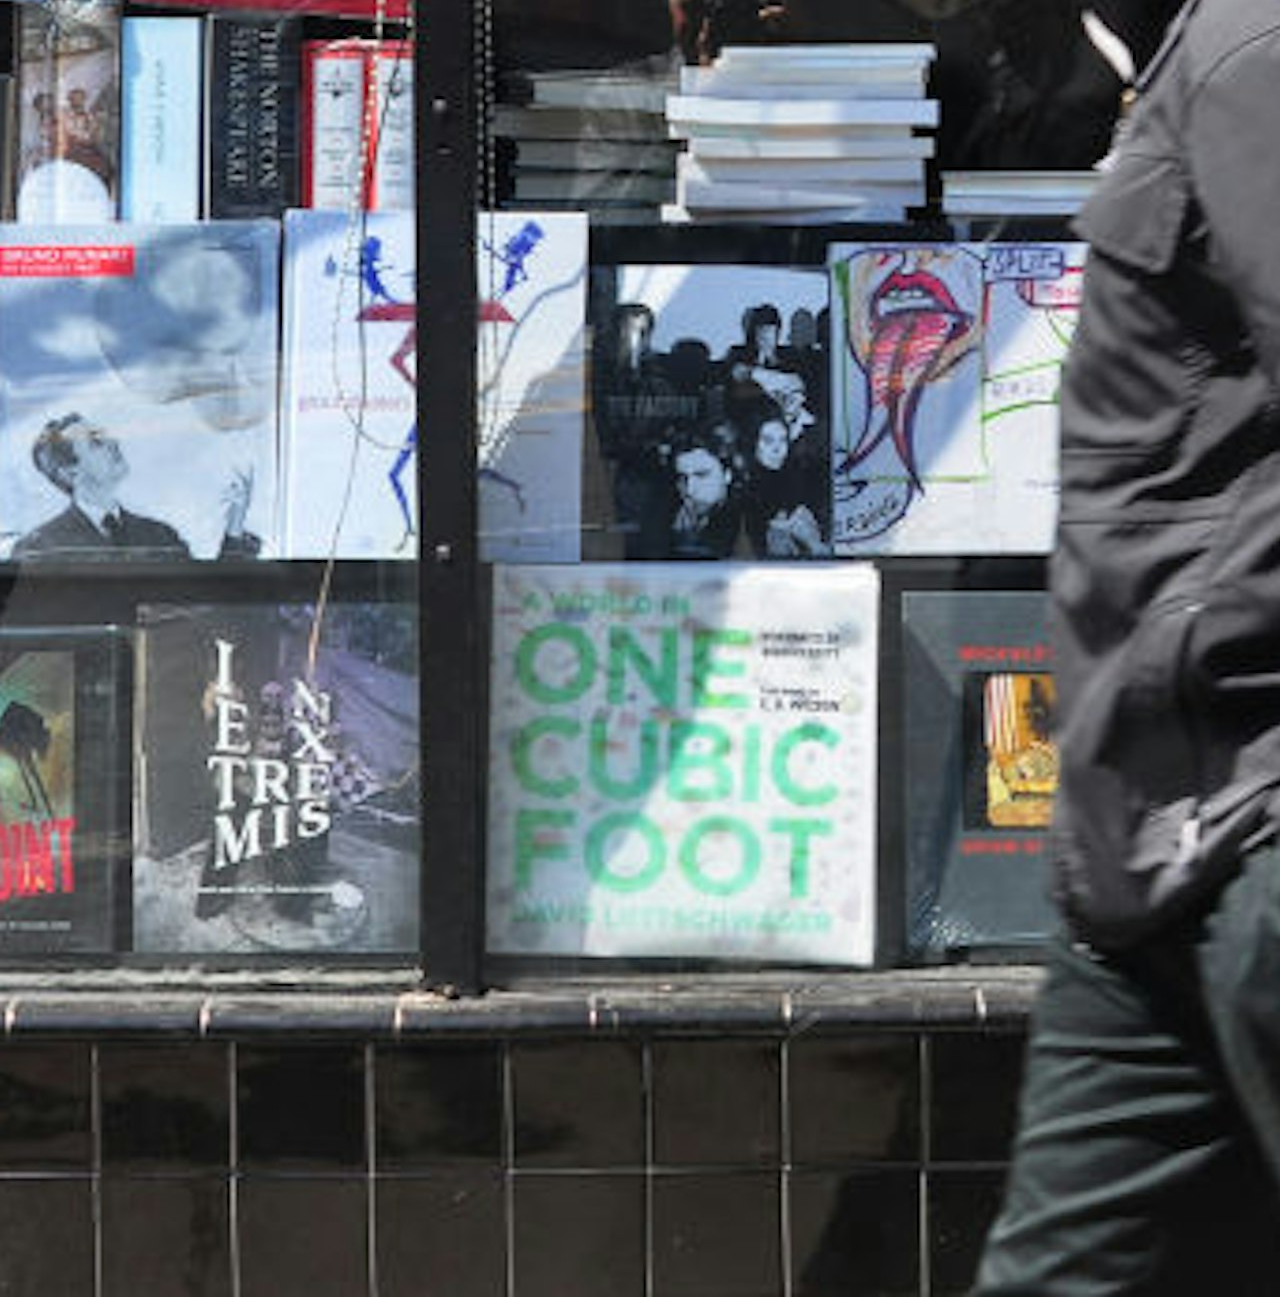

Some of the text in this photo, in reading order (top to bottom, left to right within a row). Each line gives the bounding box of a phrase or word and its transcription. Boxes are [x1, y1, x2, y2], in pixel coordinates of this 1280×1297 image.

[226, 27, 250, 189] SHAKESPEARE
[257, 28, 281, 189] THE NORTON
[513, 621, 753, 709] ONE
[509, 712, 843, 806] CUBIC
[510, 808, 835, 899] FOOT
